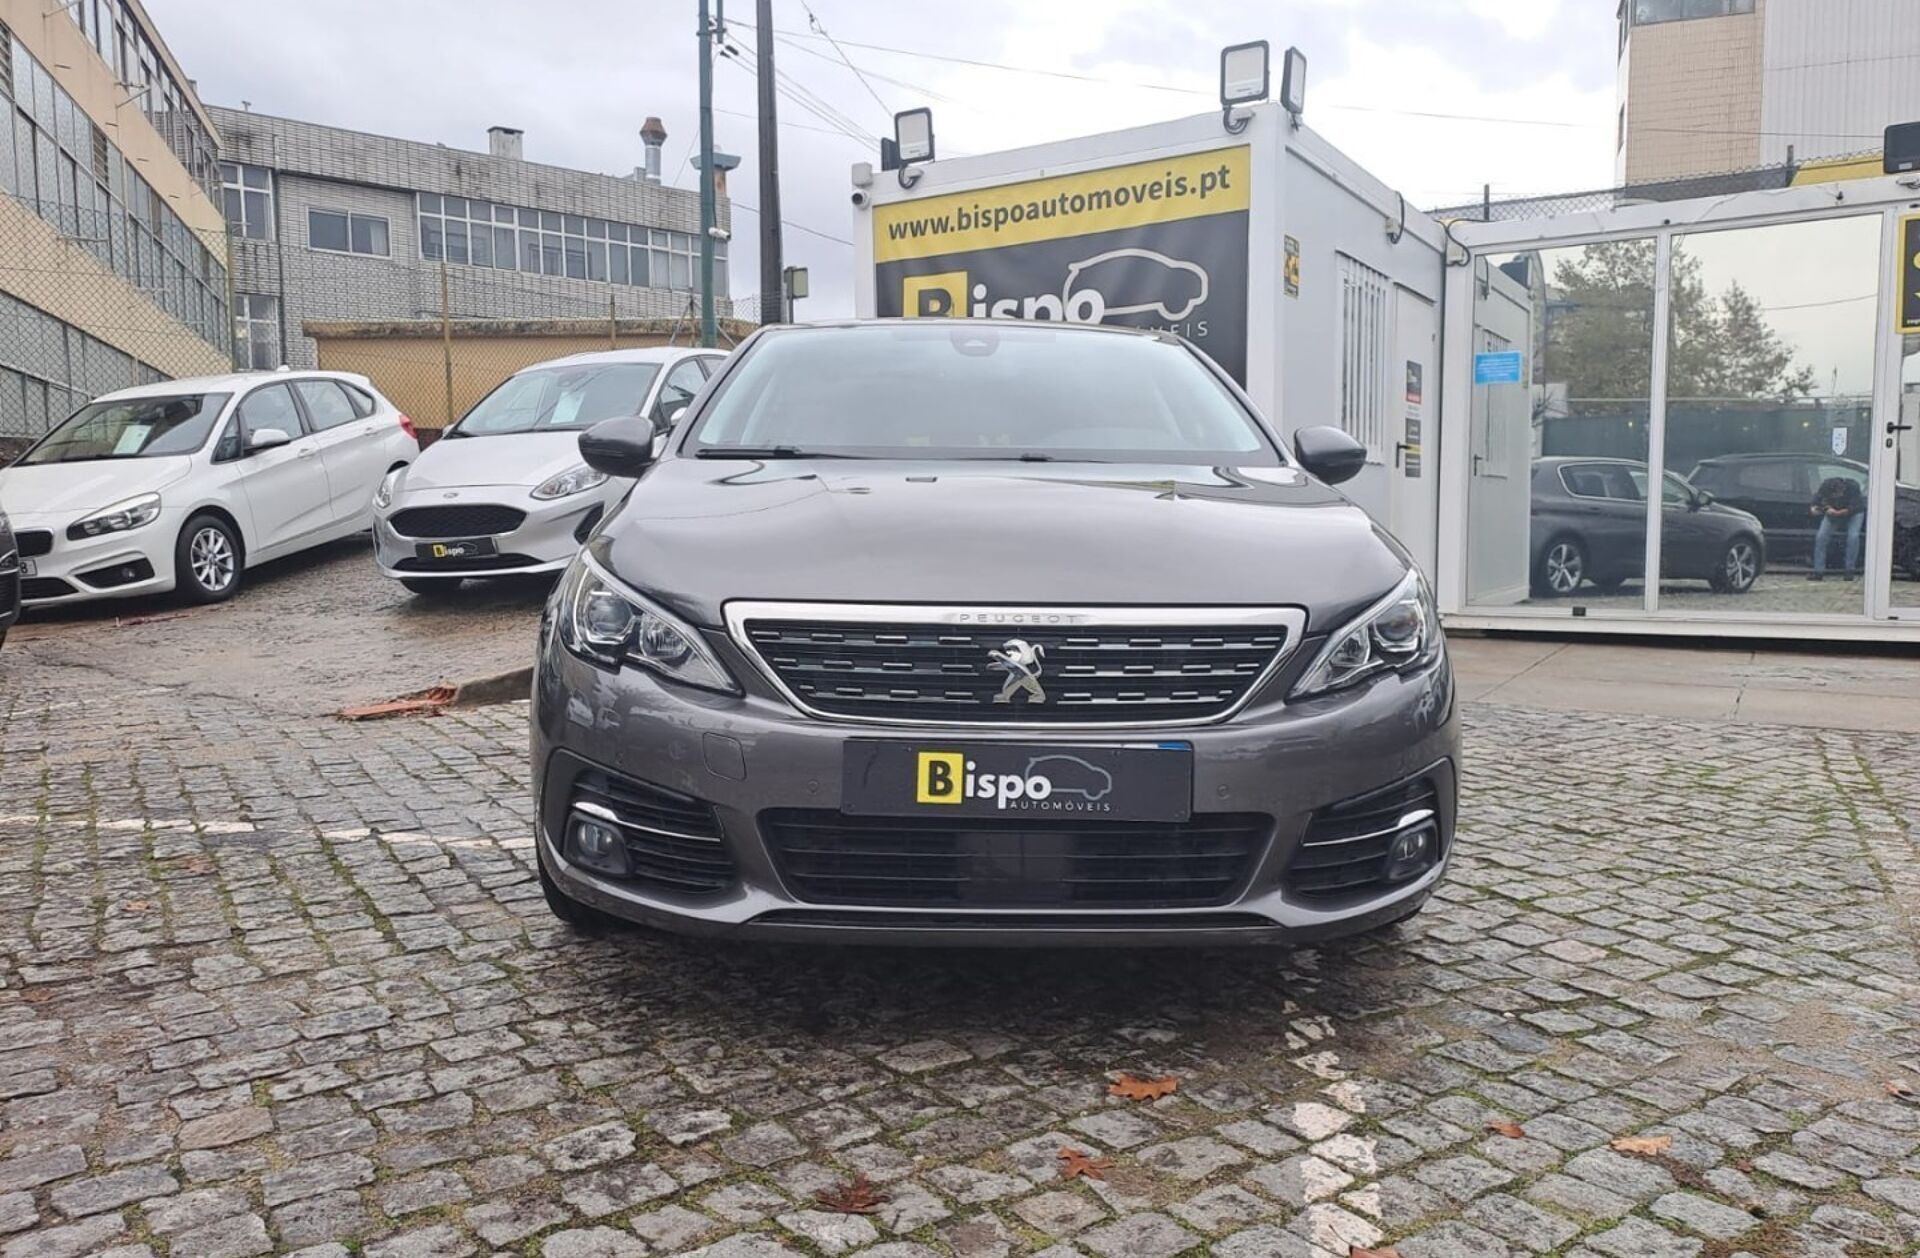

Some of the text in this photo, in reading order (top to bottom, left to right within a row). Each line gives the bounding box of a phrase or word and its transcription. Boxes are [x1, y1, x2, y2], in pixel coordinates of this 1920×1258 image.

[889, 165, 1231, 240] www.bispoautomoveis.pt
[959, 613, 1078, 623] PEUGEOT
[927, 759, 1052, 810] Bispo
[1009, 800, 1111, 812] AUTOMÓVEIS
